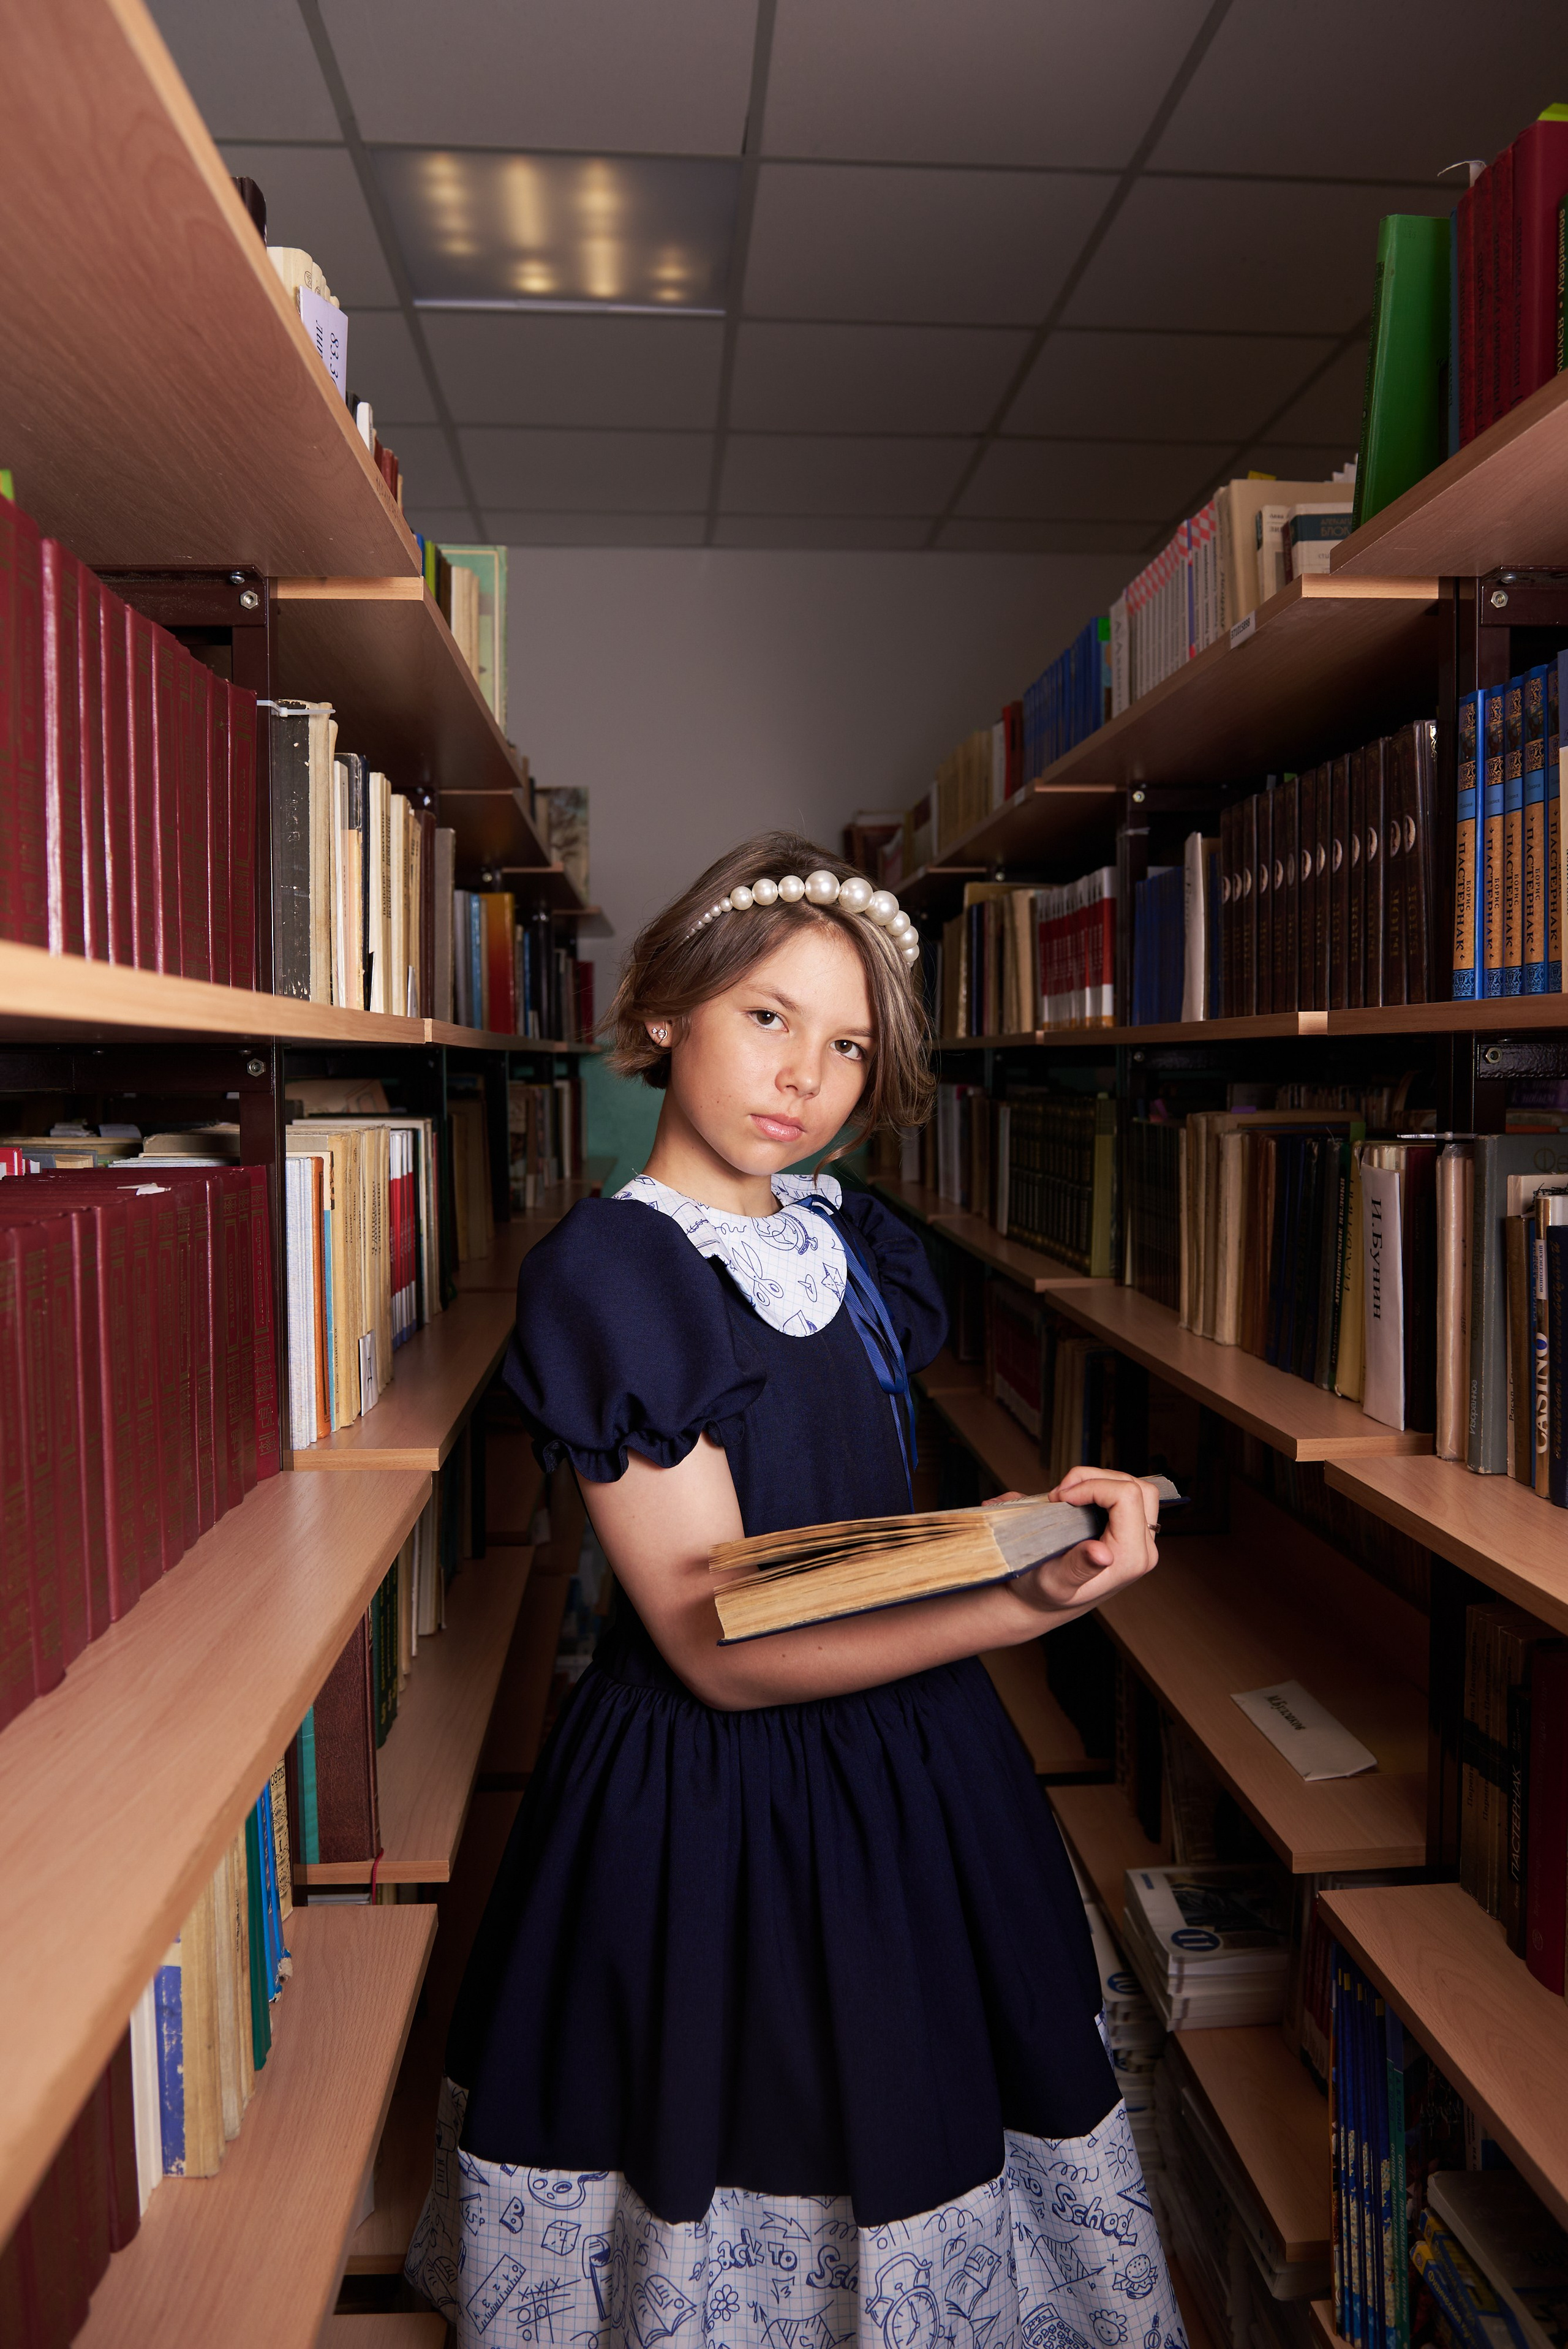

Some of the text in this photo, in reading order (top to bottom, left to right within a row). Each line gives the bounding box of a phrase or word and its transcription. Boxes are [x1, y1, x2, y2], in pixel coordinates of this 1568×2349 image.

[1456, 842, 1466, 951] ПАСТЕРНАК
[1370, 1197, 1382, 1320] И.Бунин
[1536, 1332, 1548, 1454] CASINO
[271, 1765, 285, 1786] ОЭТЫ
[1511, 1764, 1521, 1881] ПАСТЕРНАК
[806, 2245, 858, 2294] Sch
